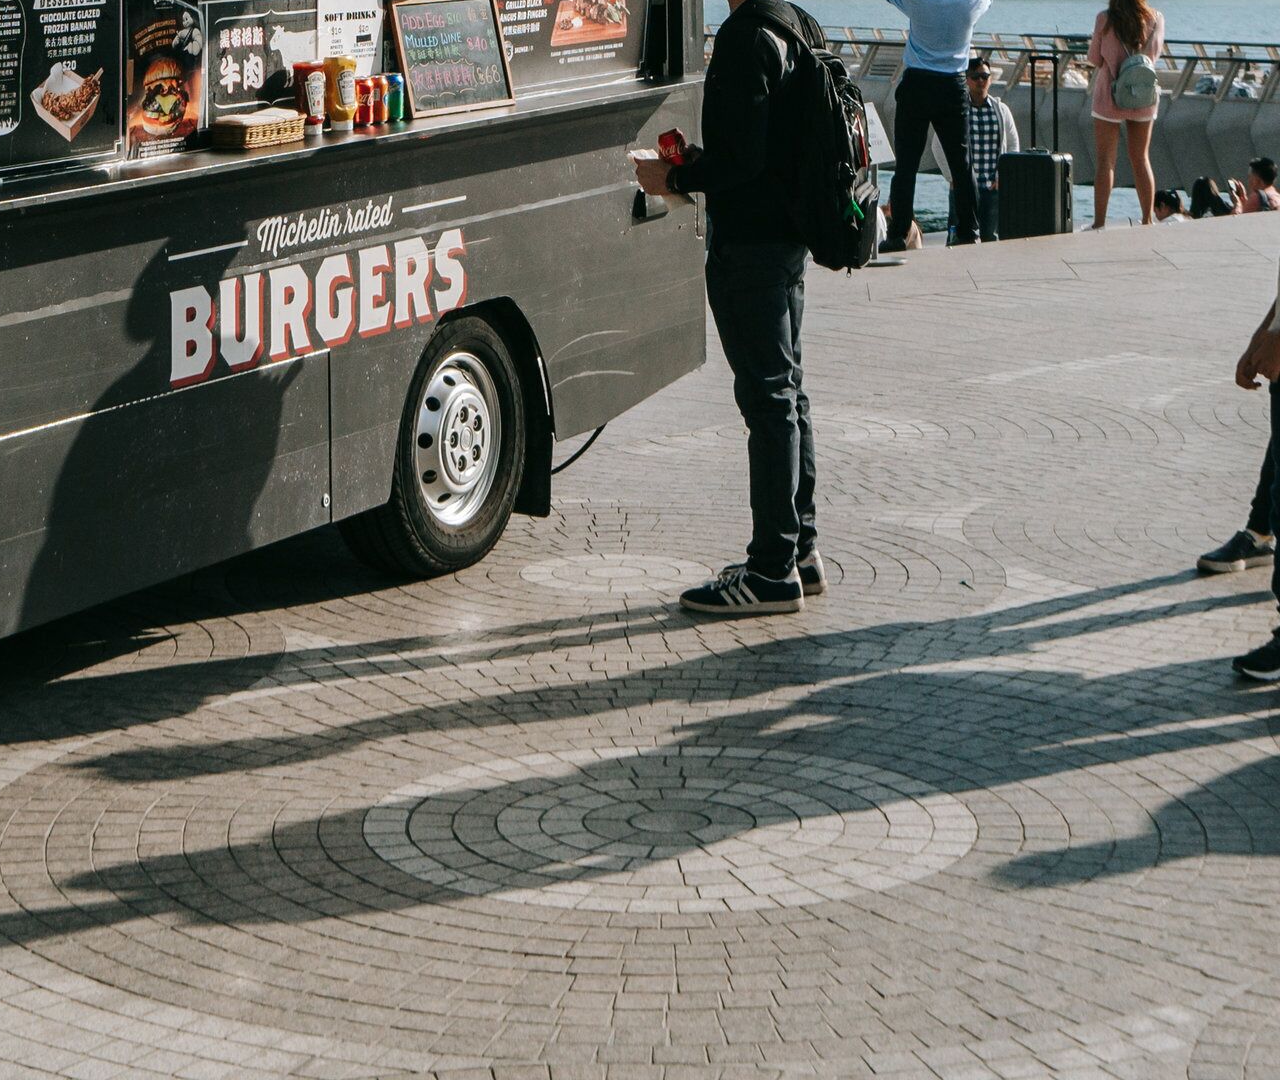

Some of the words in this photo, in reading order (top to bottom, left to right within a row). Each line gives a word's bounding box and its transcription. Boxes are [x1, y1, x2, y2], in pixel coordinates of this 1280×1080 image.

[505, 0, 526, 10] GRILLED
[40, 11, 76, 23] CHOCOLATE
[77, 9, 100, 20] GLAZED
[324, 12, 344, 23] SOFT
[346, 10, 376, 21] DRINKS
[401, 14, 424, 30] ADD
[425, 11, 445, 28] EGG
[500, 12, 517, 22] ANGUS
[517, 11, 527, 20] RIB
[527, 8, 548, 19] FINGERS
[44, 23, 69, 34] FROZEN
[70, 20, 97, 32] BANANA
[405, 34, 439, 48] MULLED
[440, 32, 462, 45] WINE
[466, 36, 488, 50] $40
[62, 60, 77, 71] $20
[220, 52, 264, 94] 牛肉
[256, 208, 343, 258] Michelin
[342, 195, 394, 236] rated
[169, 228, 468, 390] BURGERS
